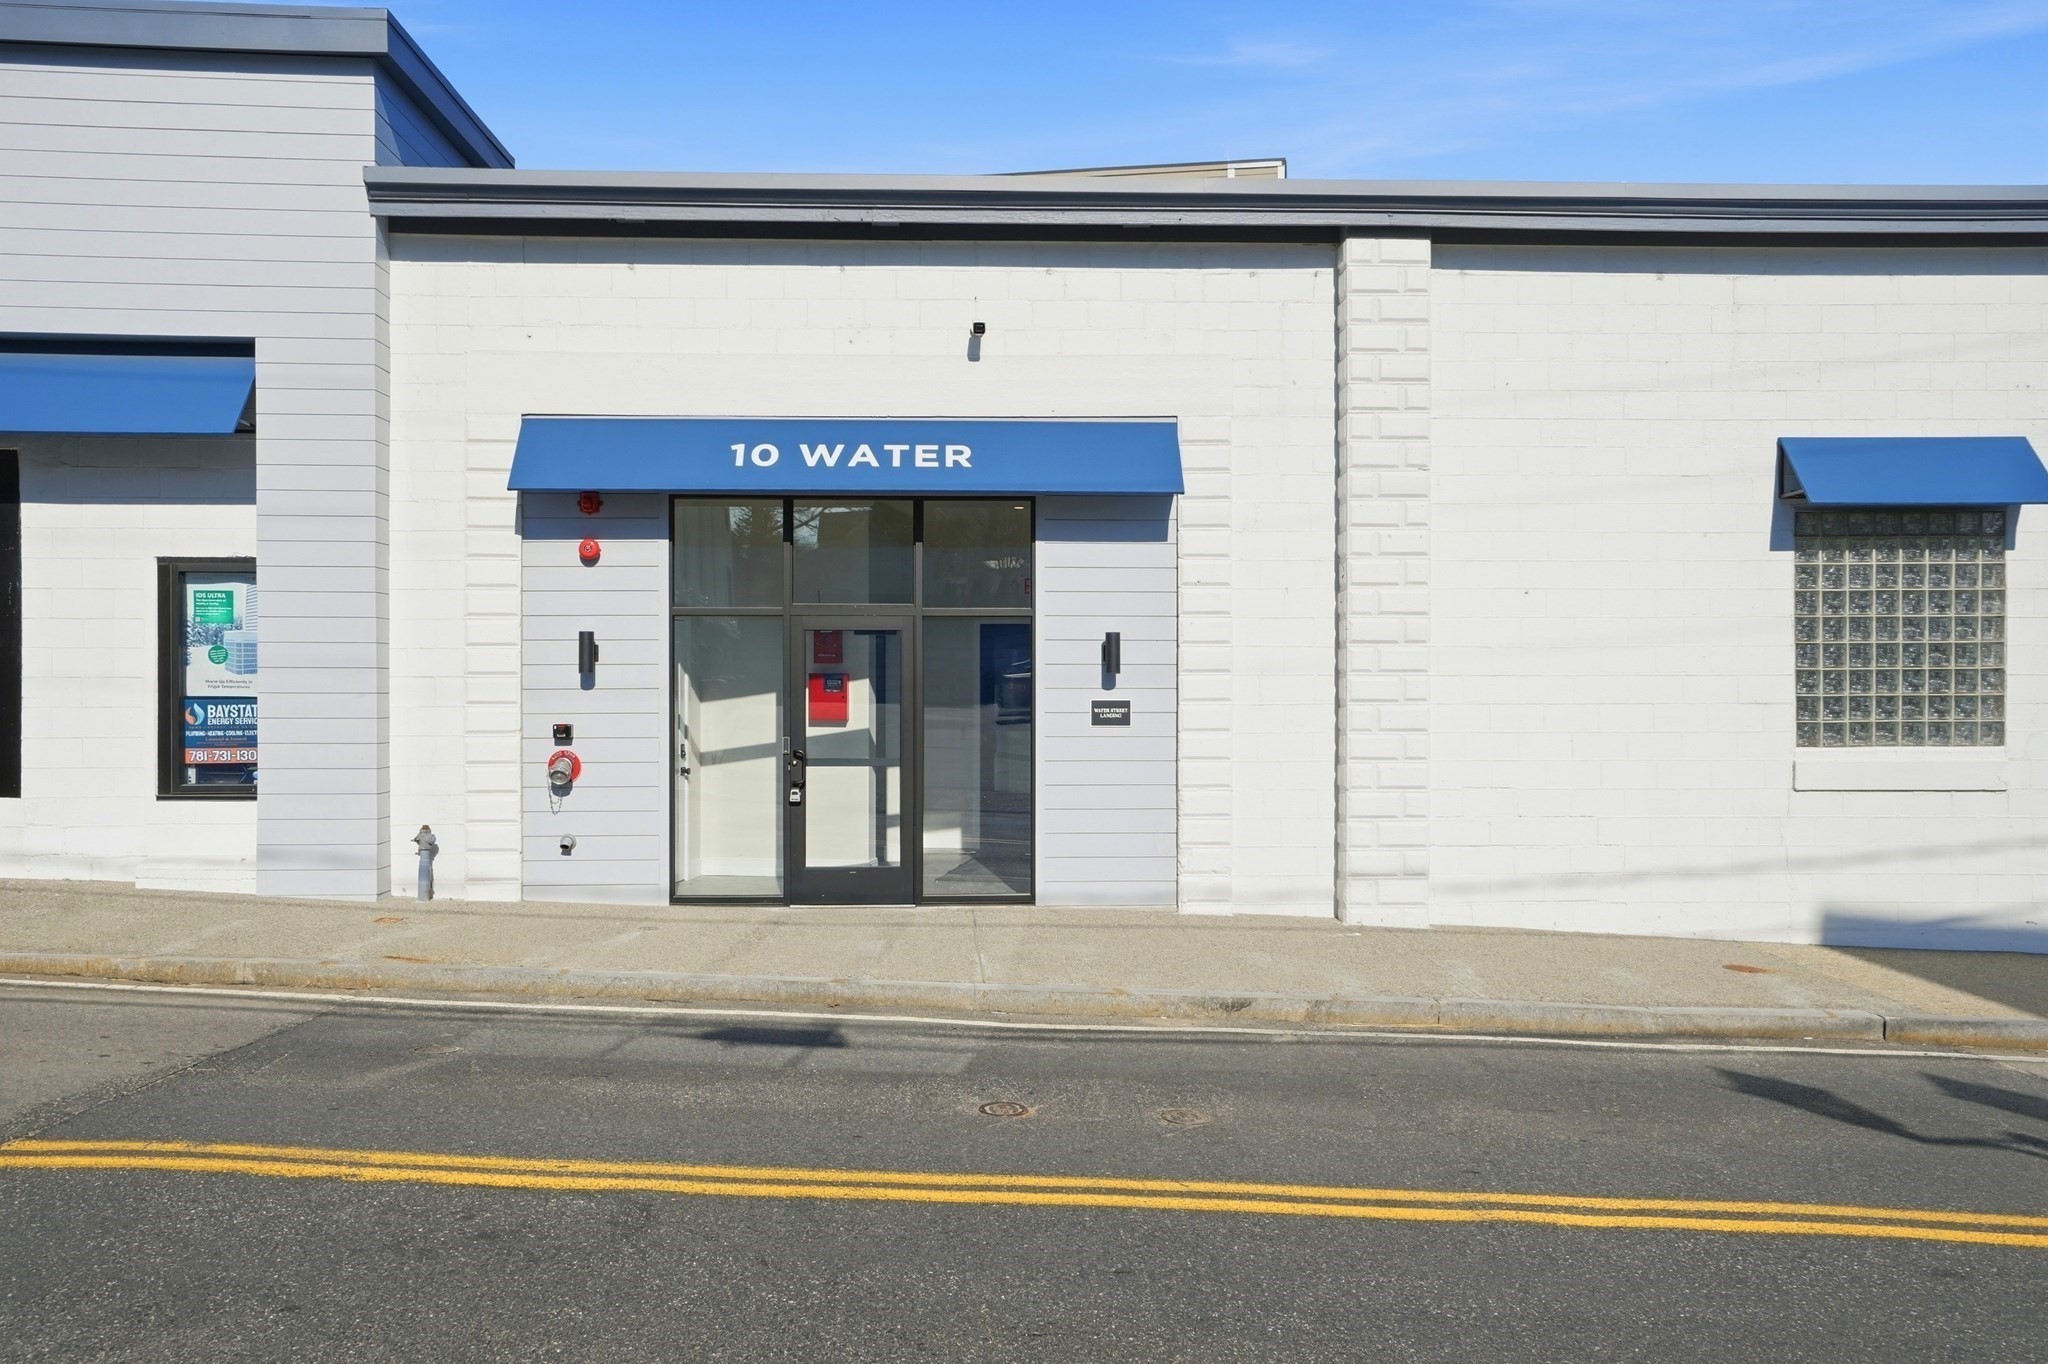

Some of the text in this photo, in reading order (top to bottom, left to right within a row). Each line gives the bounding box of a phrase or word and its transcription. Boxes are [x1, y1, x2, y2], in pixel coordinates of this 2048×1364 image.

[731, 443, 972, 468] 10 WATER
[207, 717, 234, 726] ENERGY
